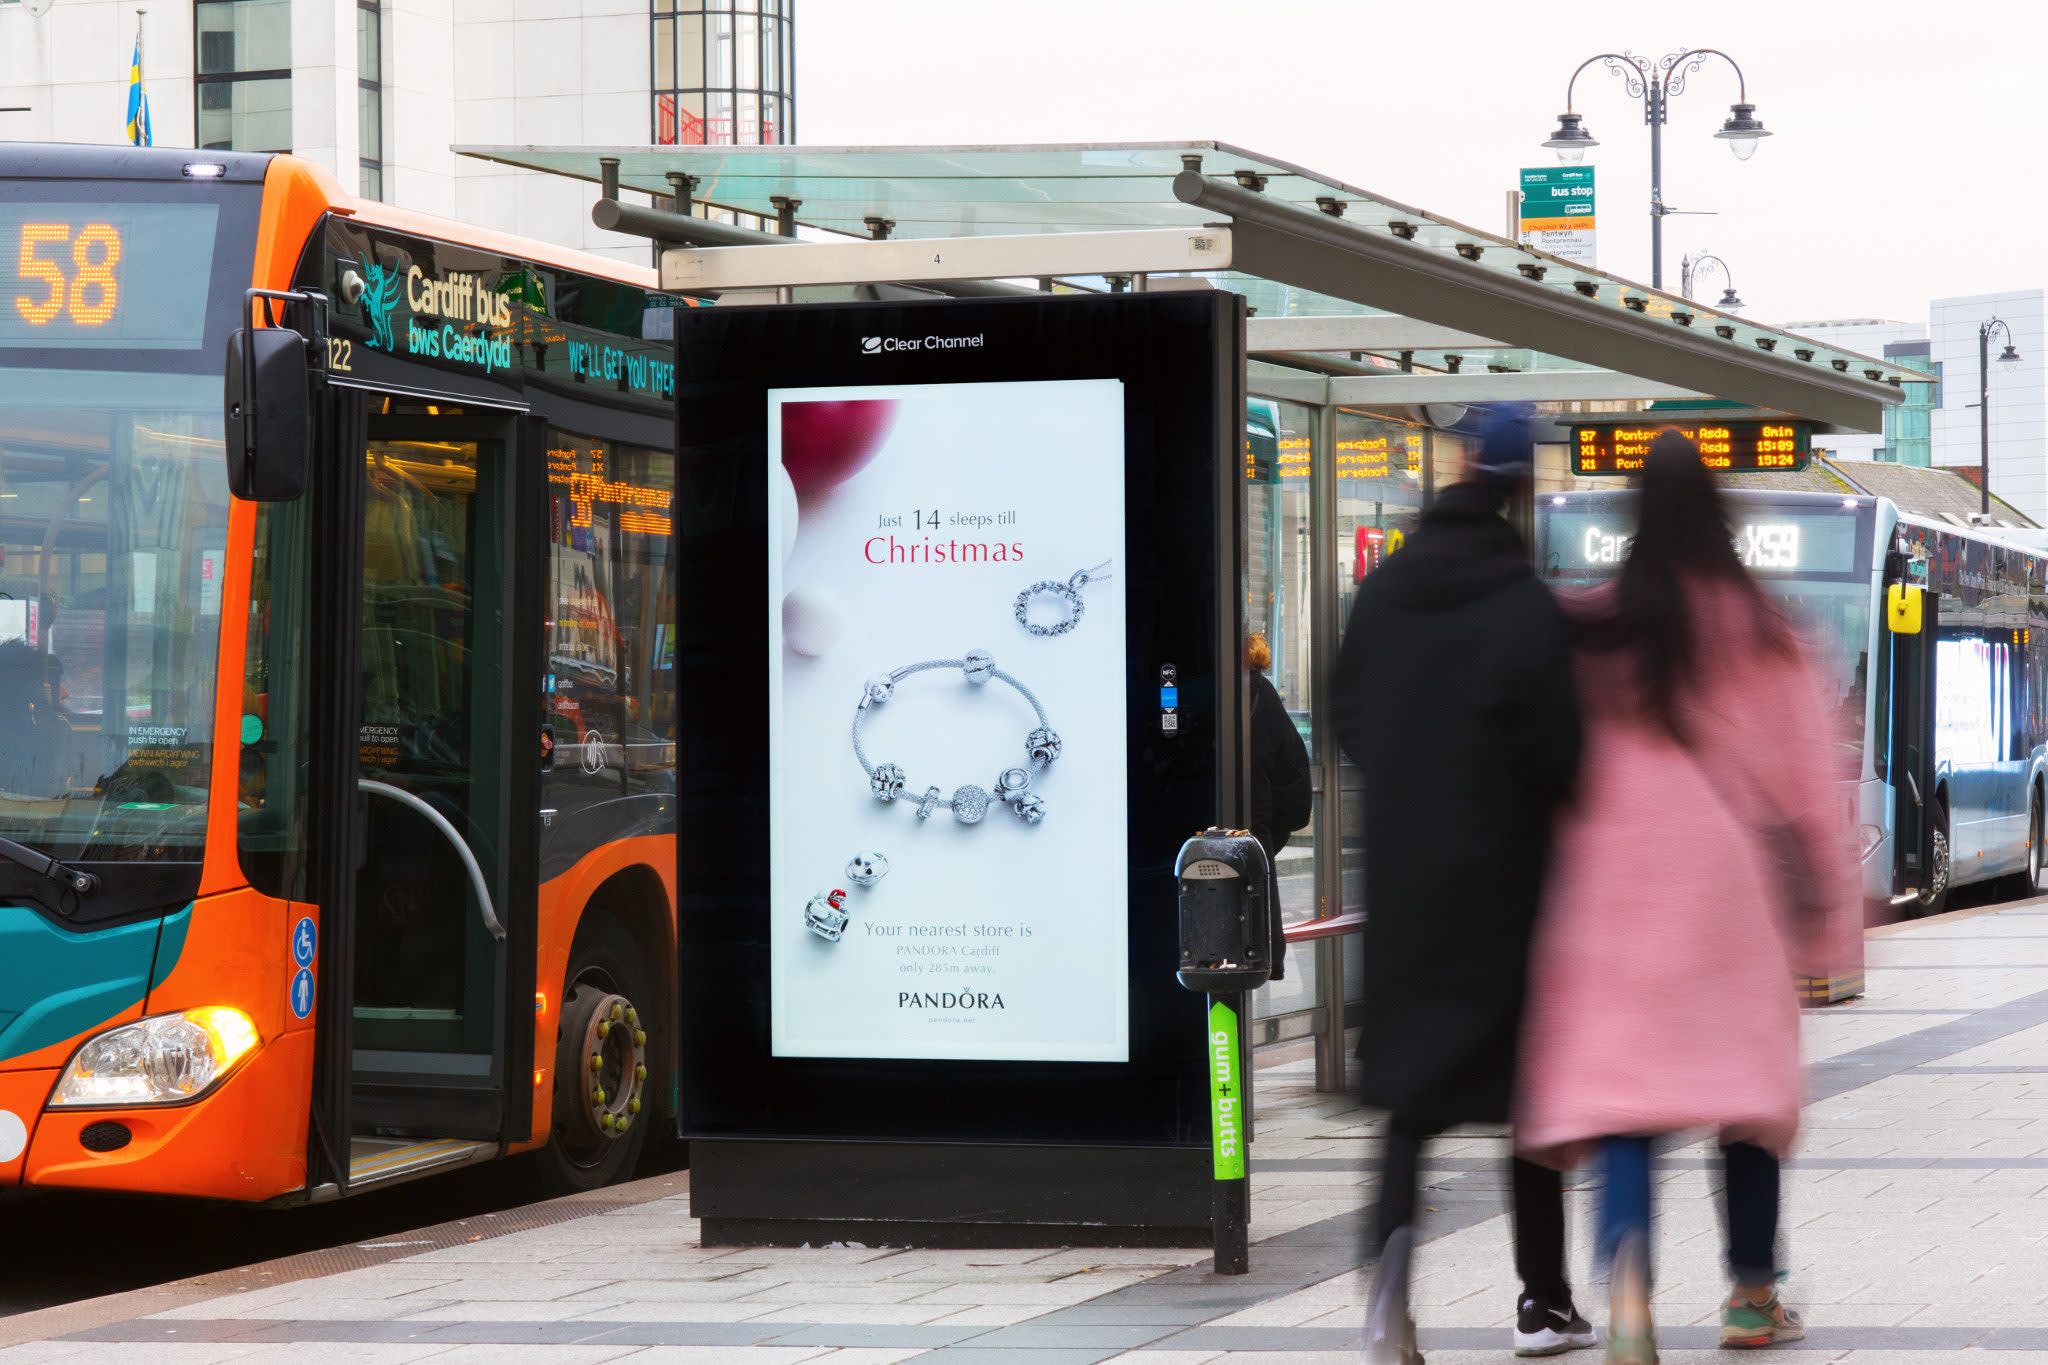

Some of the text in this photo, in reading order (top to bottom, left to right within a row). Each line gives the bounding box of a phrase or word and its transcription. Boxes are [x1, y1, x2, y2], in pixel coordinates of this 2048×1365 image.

[1551, 186, 1593, 198] bus stop
[934, 253, 941, 264] 4
[16, 223, 121, 326] 58
[407, 264, 511, 328] Cardiff bus
[408, 318, 439, 359] bws
[443, 325, 511, 373] Caerdydd
[884, 333, 984, 351] Clear Channel
[328, 338, 352, 371] 122
[568, 340, 601, 378] WE'LL
[603, 345, 624, 381] GET
[626, 355, 647, 389] YOU
[1580, 430, 1597, 442] 57
[1699, 427, 1729, 439] Asda
[1762, 425, 1793, 438] 8min
[1581, 445, 1596, 456] X1
[1700, 441, 1730, 453] Asda
[1757, 440, 1794, 452] 15:09
[1581, 459, 1597, 471] X1
[1757, 454, 1794, 467] 15:24
[879, 509, 1016, 530] Just 14 sleeps till
[865, 535, 1024, 564] Christmas
[1745, 525, 1799, 568] X59
[128, 726, 187, 736] IN EMERGENCY
[128, 736, 178, 746] push to open
[864, 922, 1033, 937] Your nearest store is
[896, 944, 1000, 957] PANDORA Cardiff
[899, 962, 923, 975] only
[898, 987, 1005, 1010] PANDORA
